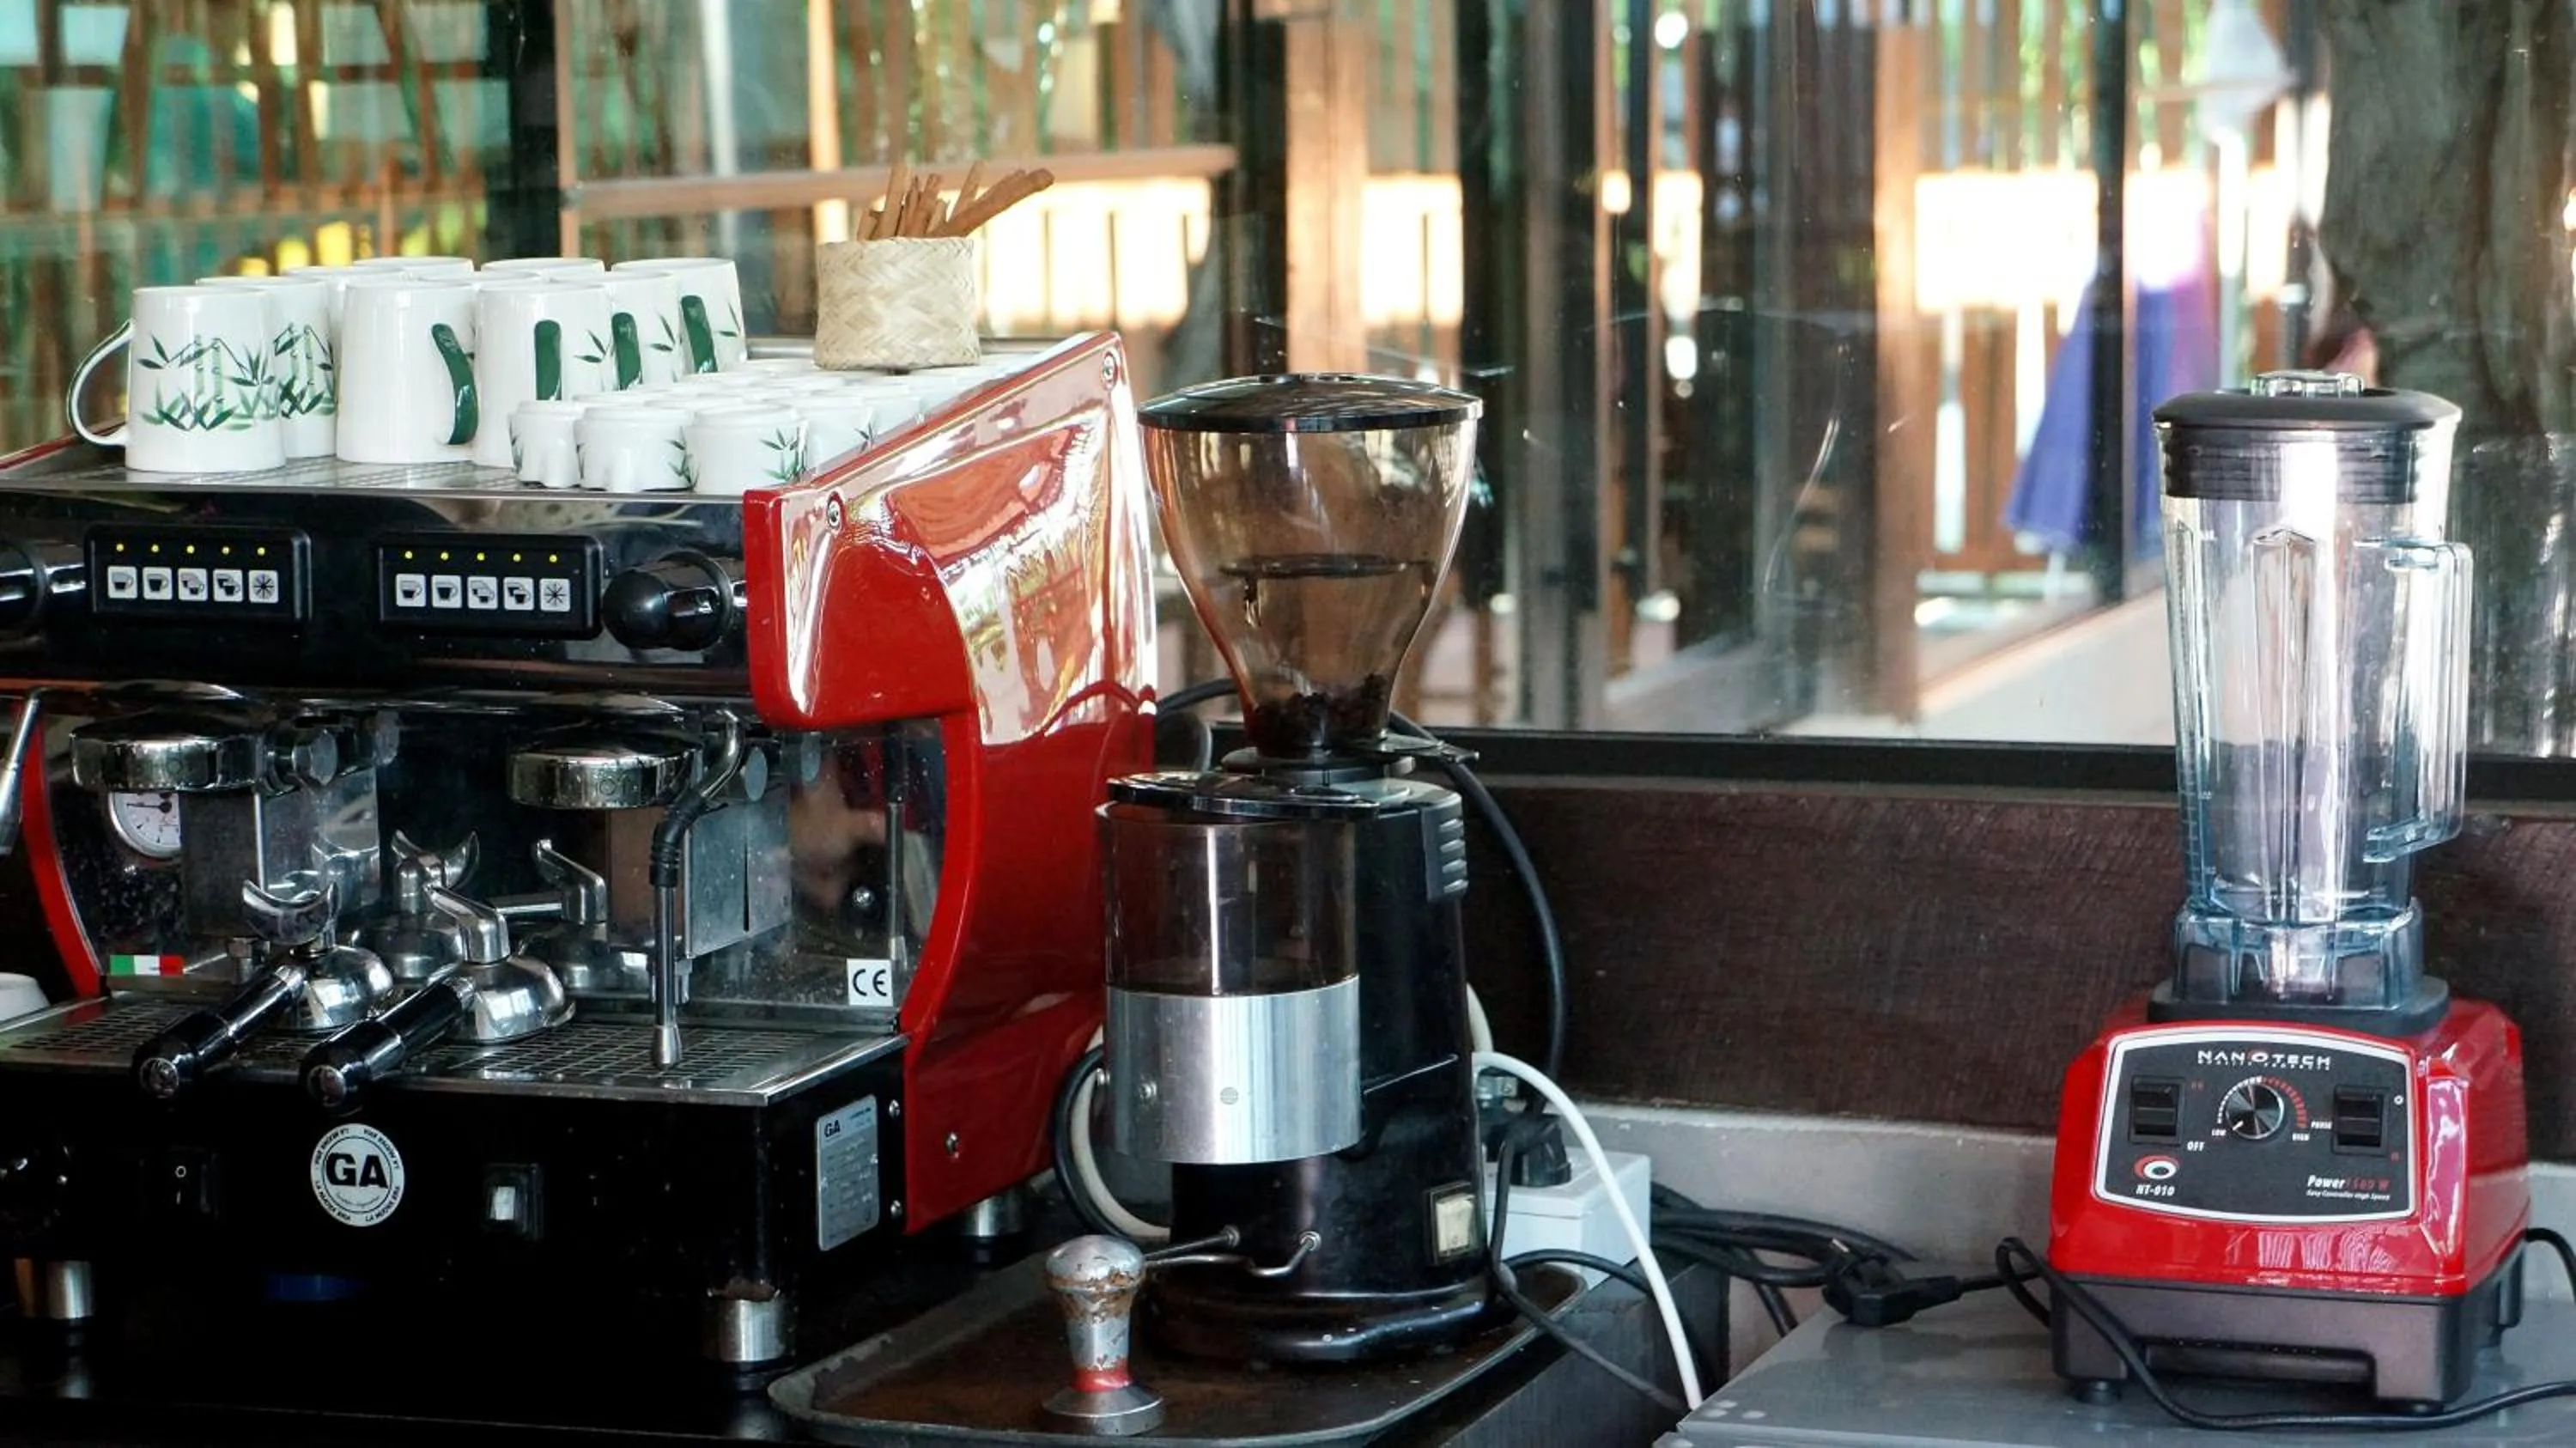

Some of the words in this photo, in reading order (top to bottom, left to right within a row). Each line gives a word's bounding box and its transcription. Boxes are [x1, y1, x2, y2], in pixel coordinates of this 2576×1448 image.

[853, 968, 888, 997] CE
[2196, 1049, 2332, 1068] NANOTECH
[824, 1120, 841, 1137] GA
[2186, 1141, 2205, 1152] OFF
[325, 1152, 389, 1189] GA
[2307, 1174, 2346, 1189] Power
